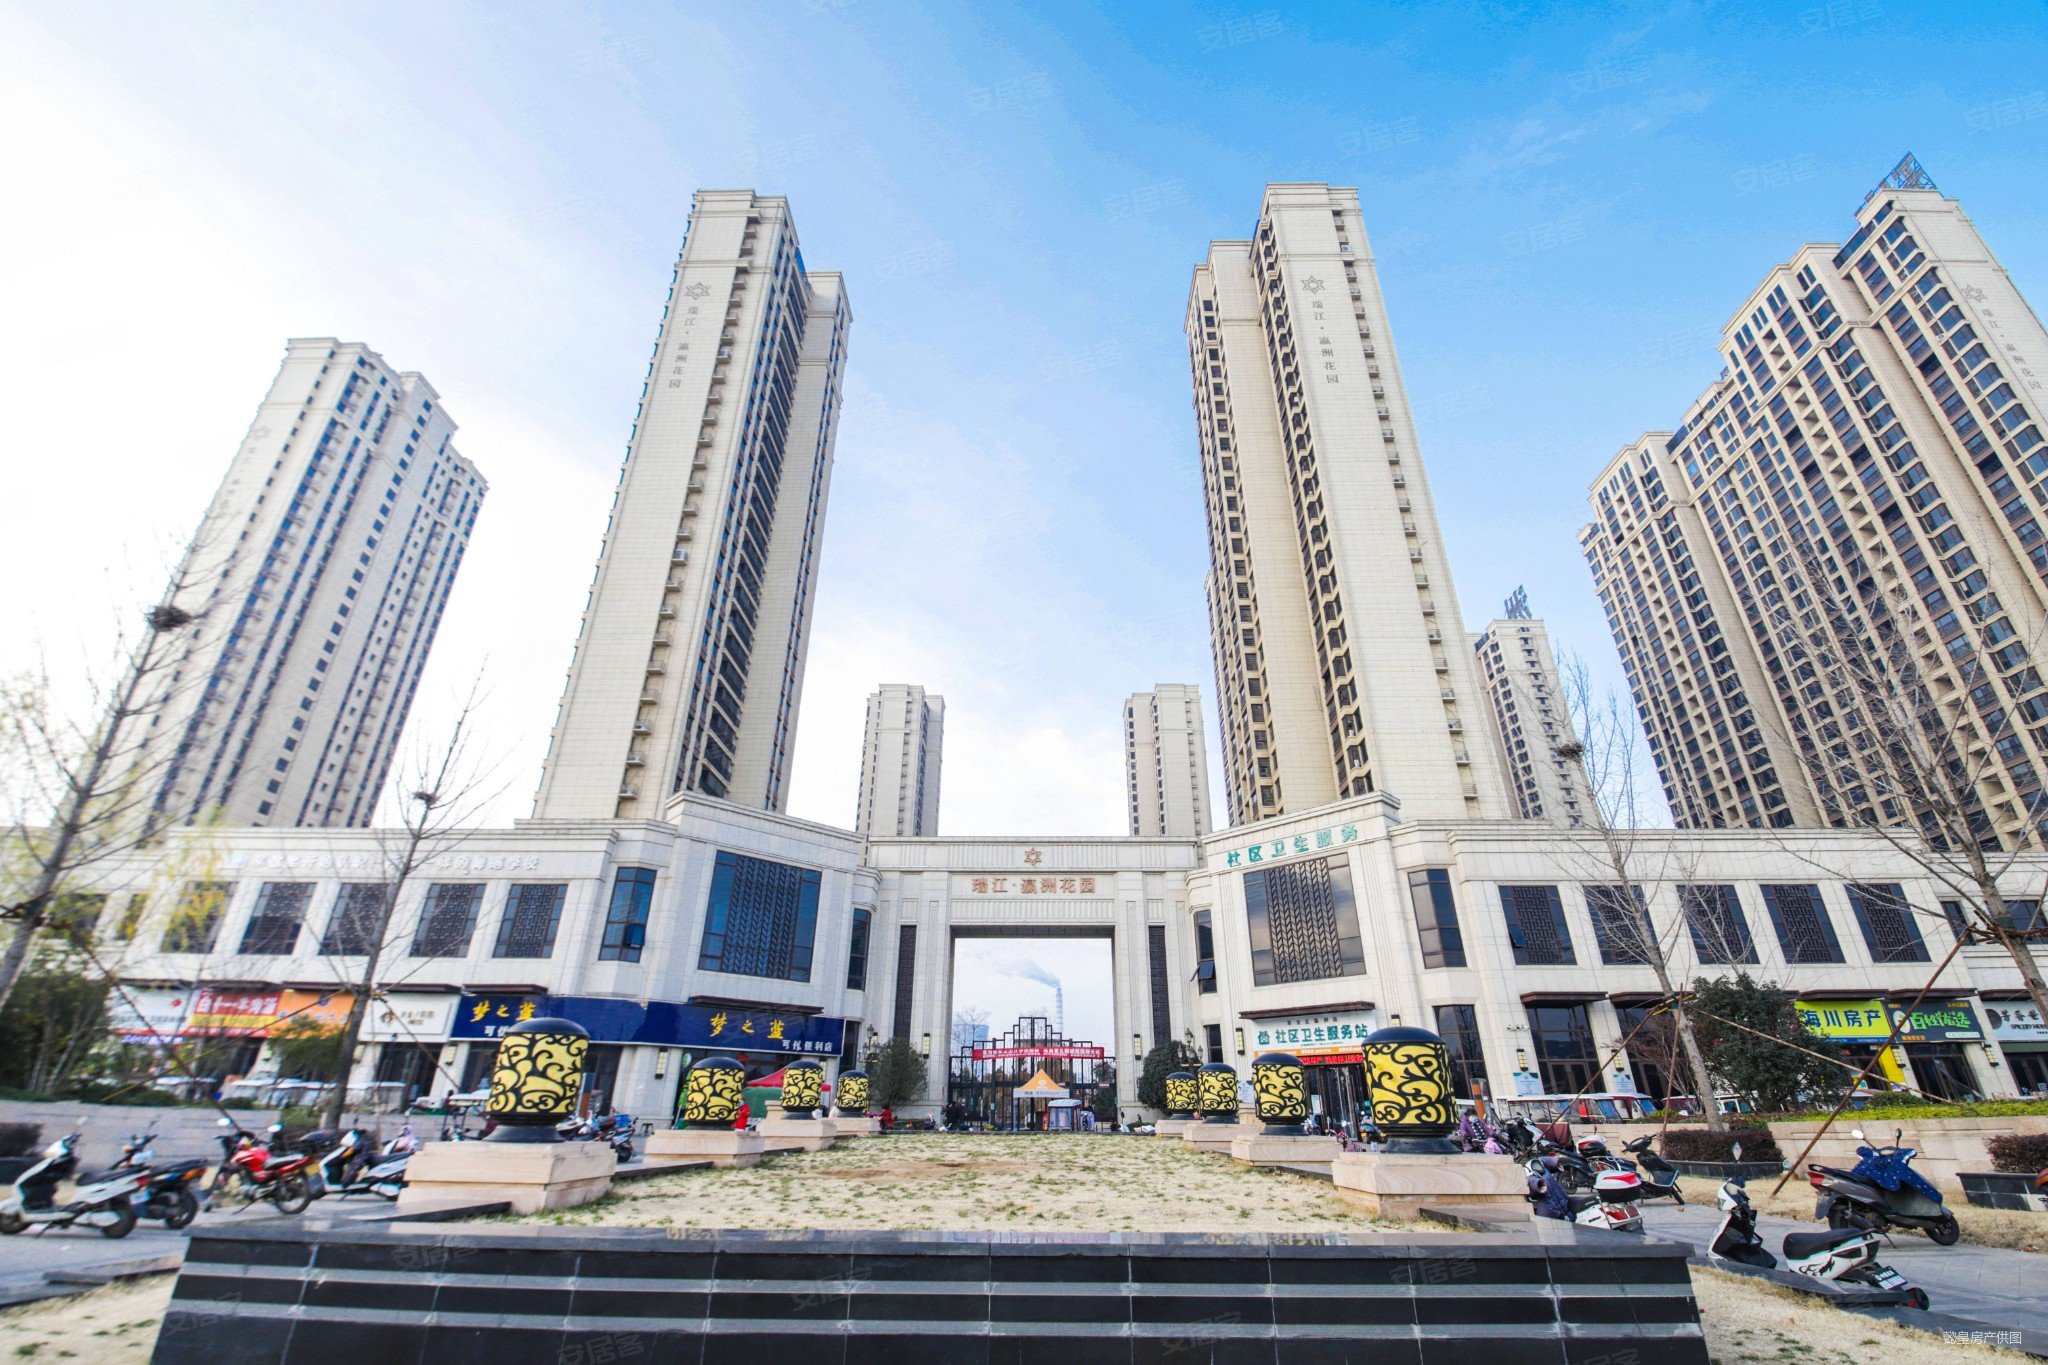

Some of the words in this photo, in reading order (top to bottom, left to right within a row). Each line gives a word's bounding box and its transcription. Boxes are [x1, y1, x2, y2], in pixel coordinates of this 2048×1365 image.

[1227, 823, 1358, 868] 社区卫生服务
[470, 1000, 536, 1022] 梦之蓝
[1803, 1009, 1881, 1028] 海川房产
[709, 1012, 785, 1040] 梦之蓝
[1275, 1023, 1369, 1044] 社区卫生服务站
